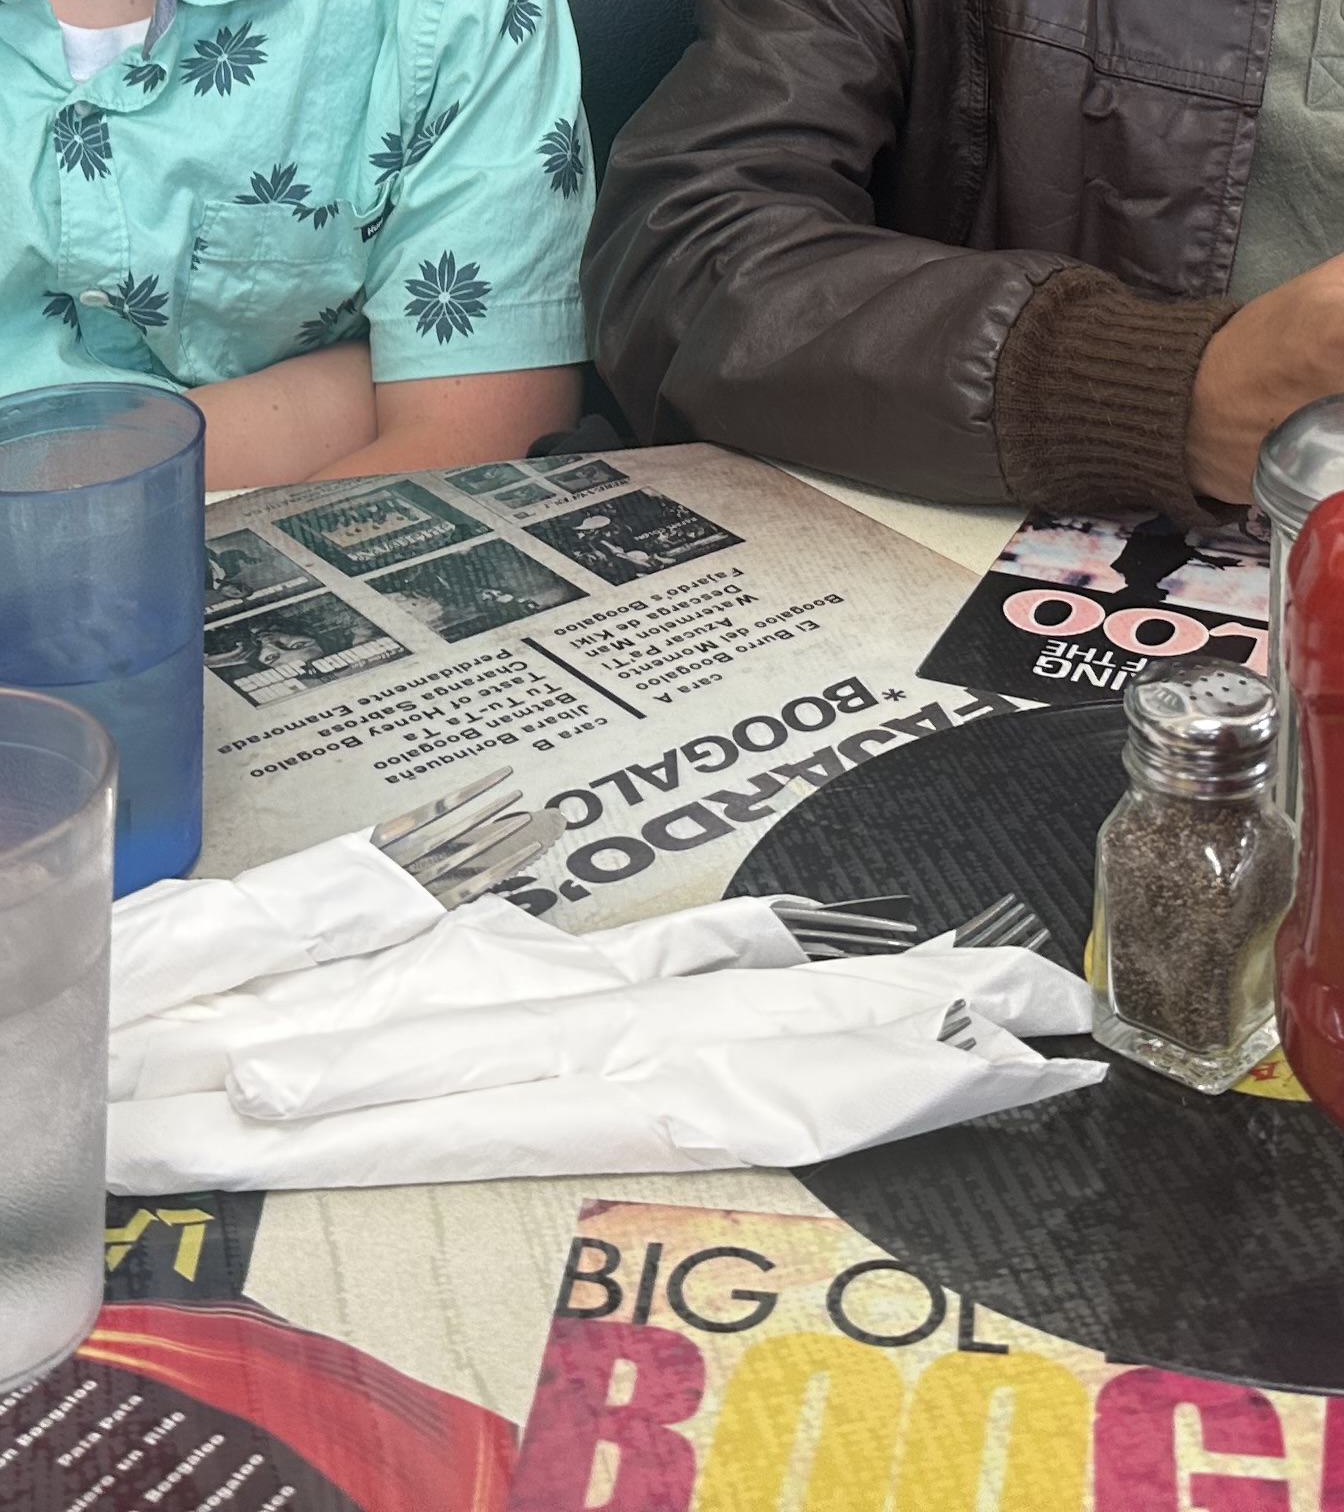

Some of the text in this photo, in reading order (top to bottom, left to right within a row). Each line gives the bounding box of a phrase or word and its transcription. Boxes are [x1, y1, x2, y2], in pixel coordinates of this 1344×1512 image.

[553, 567, 745, 636] Fajardo's Boogaloo
[569, 584, 743, 649] Descarga de Kiki
[584, 594, 759, 658] Watermelon Man
[665, 617, 733, 647] Azucar
[617, 593, 845, 679] Boogaloo del Momento
[635, 619, 821, 690] El Burro Boogaloo
[1039, 638, 1117, 668] THE
[357, 648, 514, 706] Perdidamente
[420, 661, 528, 701] Charanga
[653, 673, 723, 704] cara A
[1032, 653, 1131, 691] ING
[217, 704, 354, 755] Enamorada
[249, 672, 547, 778] Taste of Honey Boogaloo
[317, 700, 417, 738] Sabrosa
[373, 692, 578, 770] Batman Boogaloo
[384, 704, 589, 784] Jibara Borinqueña
[402, 683, 563, 742] Tu Tu-Ta Ta
[532, 717, 608, 752] cara B
[556, 1236, 779, 1334] BIG
[15, 1380, 98, 1447] Boogaloo
[56, 1395, 143, 1467] Pata Pata
[144, 1434, 225, 1503] Boogaloo
[198, 1454, 264, 1512] oogaloo
